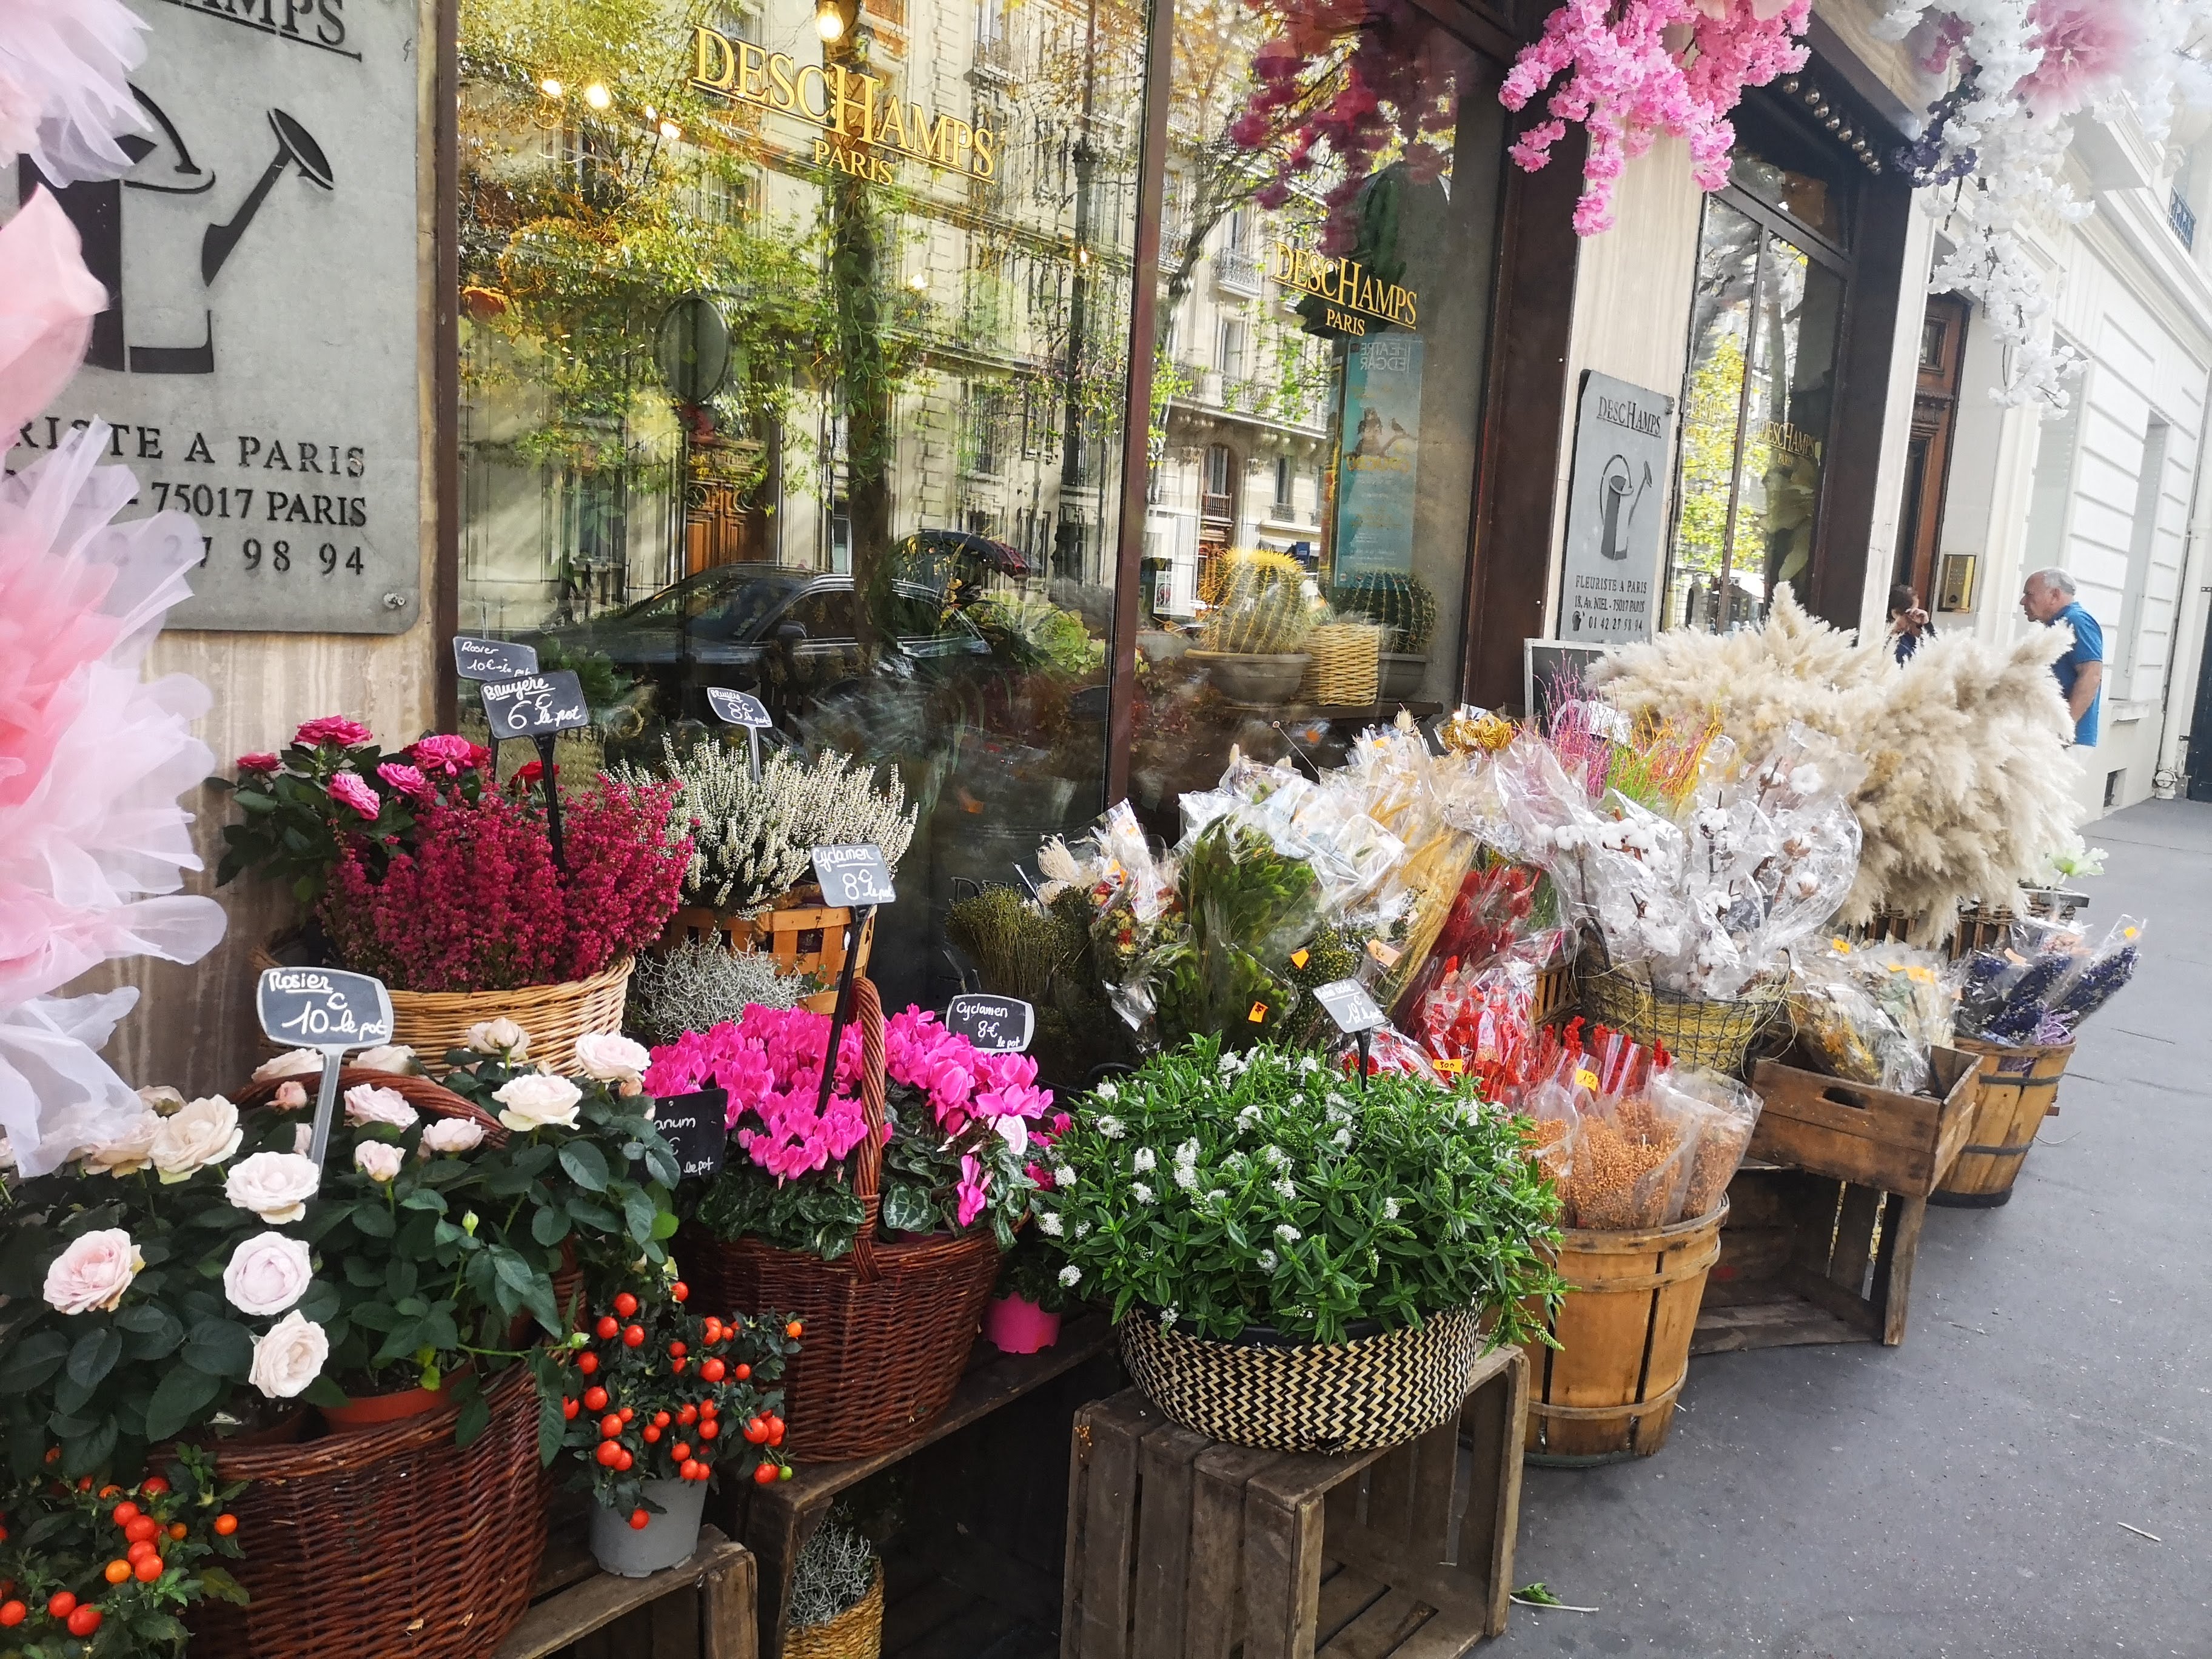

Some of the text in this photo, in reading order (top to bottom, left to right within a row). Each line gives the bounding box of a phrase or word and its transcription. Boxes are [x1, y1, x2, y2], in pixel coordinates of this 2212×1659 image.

[692, 24, 994, 178] DESCHAMPS
[812, 138, 894, 186] PARIS
[1273, 241, 1418, 326] DESCHAMPS
[1326, 308, 1366, 337] PARIS
[1598, 396, 1661, 435] DESCHAMPS
[184, 432, 216, 464] A
[238, 436, 366, 478] PARIS
[152, 482, 253, 518] 75017
[267, 492, 367, 526] PARIS
[243, 538, 291, 572] 98
[320, 544, 364, 575] 94
[1575, 575, 1647, 594] FLEURISTE A PARIS
[1613, 599, 1629, 612] 75017
[1589, 616, 1597, 629] 01
[1600, 617, 1609, 630] 42
[1612, 618, 1621, 630] 27
[554, 705, 582, 727] pot
[813, 845, 874, 873] Cyclamen
[269, 971, 333, 992] Rosier
[956, 1001, 1008, 1021] Cyclamen
[330, 1009, 358, 1034] le
[358, 1019, 388, 1042] pot
[996, 1036, 1006, 1048] le
[1007, 1036, 1021, 1049] pot
[654, 1117, 696, 1131] anum
[698, 1156, 714, 1176] pot
